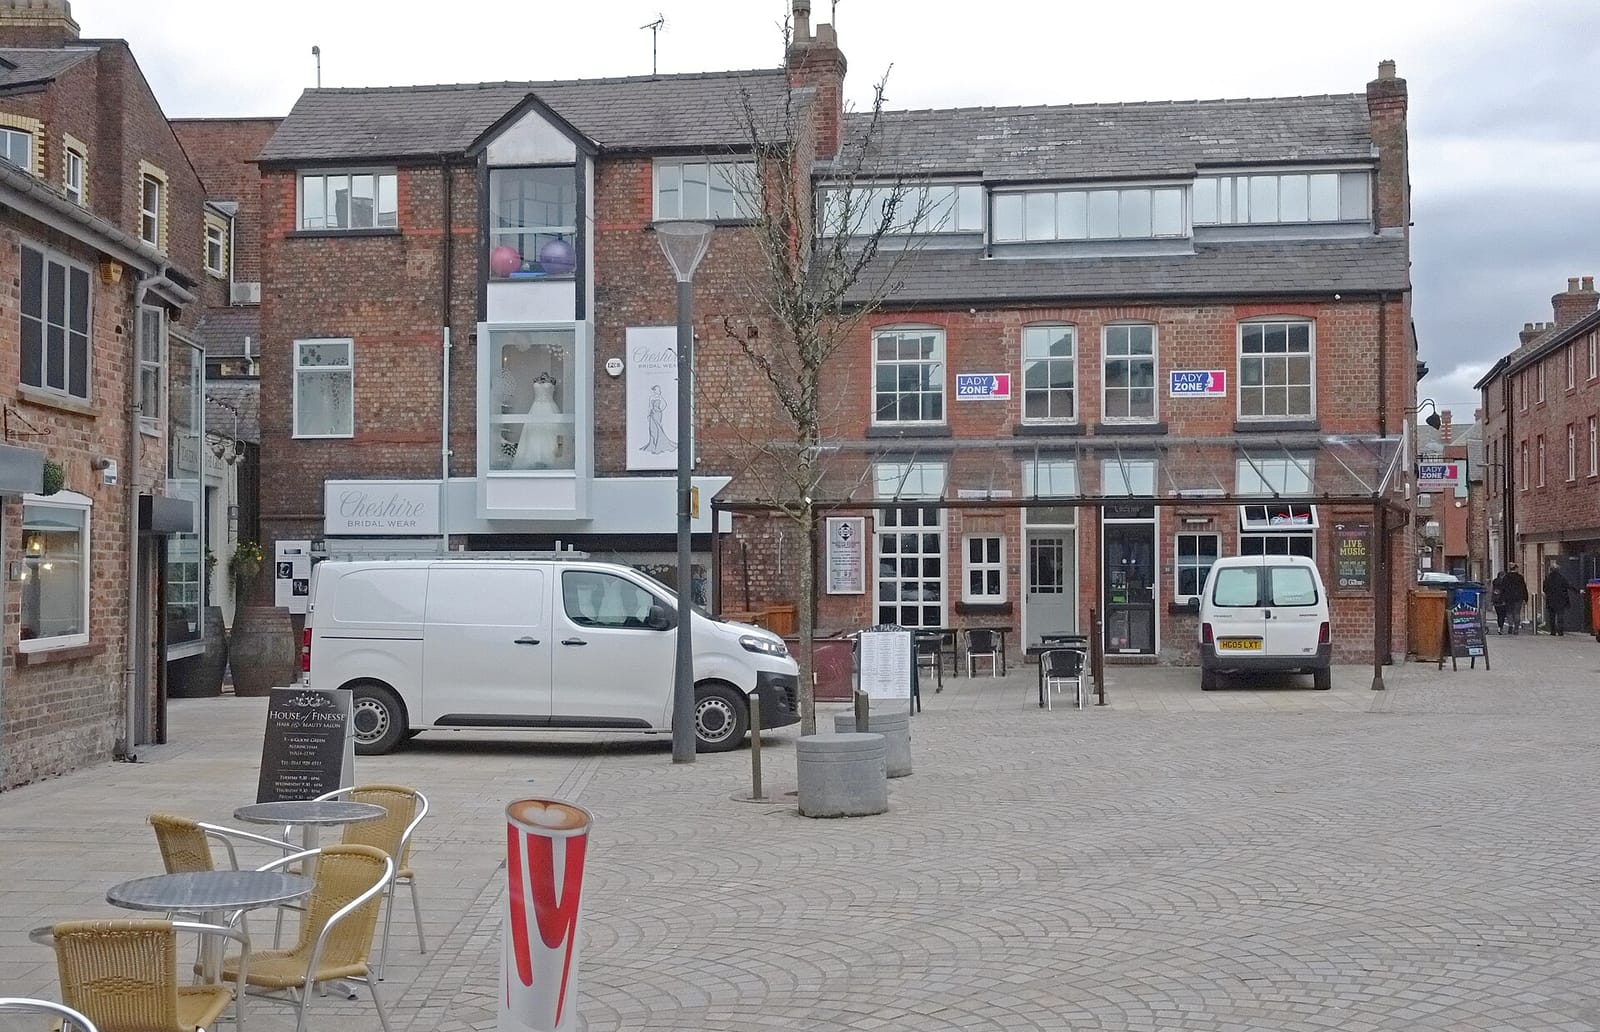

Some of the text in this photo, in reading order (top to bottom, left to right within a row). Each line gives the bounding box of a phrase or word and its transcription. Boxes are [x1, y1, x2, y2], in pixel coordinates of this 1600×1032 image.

[960, 377, 988, 386] LADY
[1174, 373, 1203, 382] LADY
[960, 386, 988, 394] ZONE
[1174, 382, 1203, 391] ZONE
[339, 490, 425, 518] Cheshire
[347, 520, 416, 528] BRIDAL WEAR
[1343, 539, 1363, 548] LIVE
[1340, 547, 1366, 556] MUSIC
[1243, 641, 1259, 649] LXT
[269, 710, 301, 720] HOUSE
[312, 711, 345, 721] FINESSE
